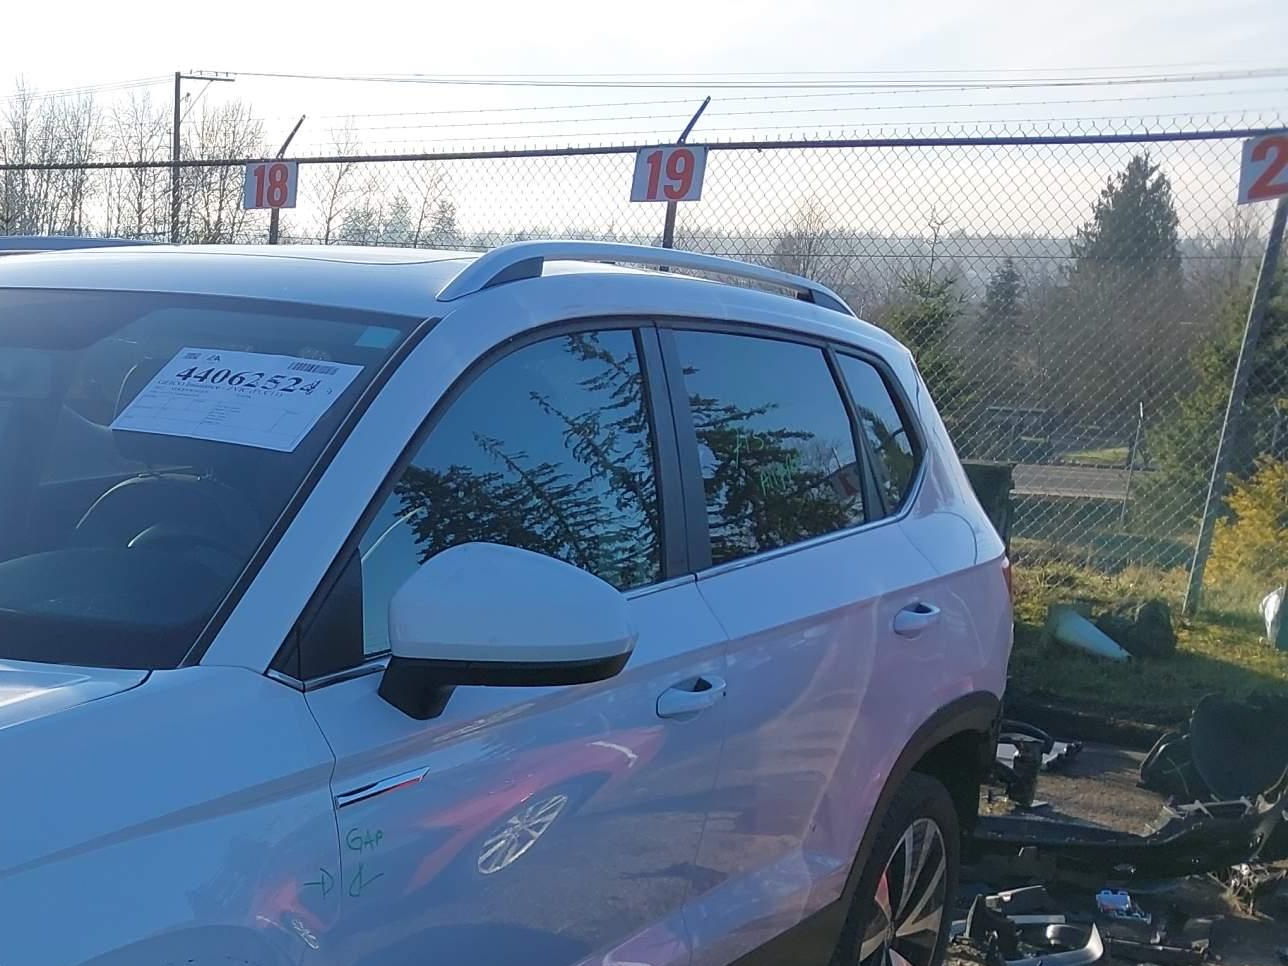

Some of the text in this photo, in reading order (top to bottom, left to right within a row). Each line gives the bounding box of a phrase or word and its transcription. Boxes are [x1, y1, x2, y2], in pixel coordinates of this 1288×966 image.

[253, 163, 288, 208] 18
[646, 148, 696, 199] 19
[176, 366, 321, 394] 44062524
[346, 828, 384, 852] GAP
